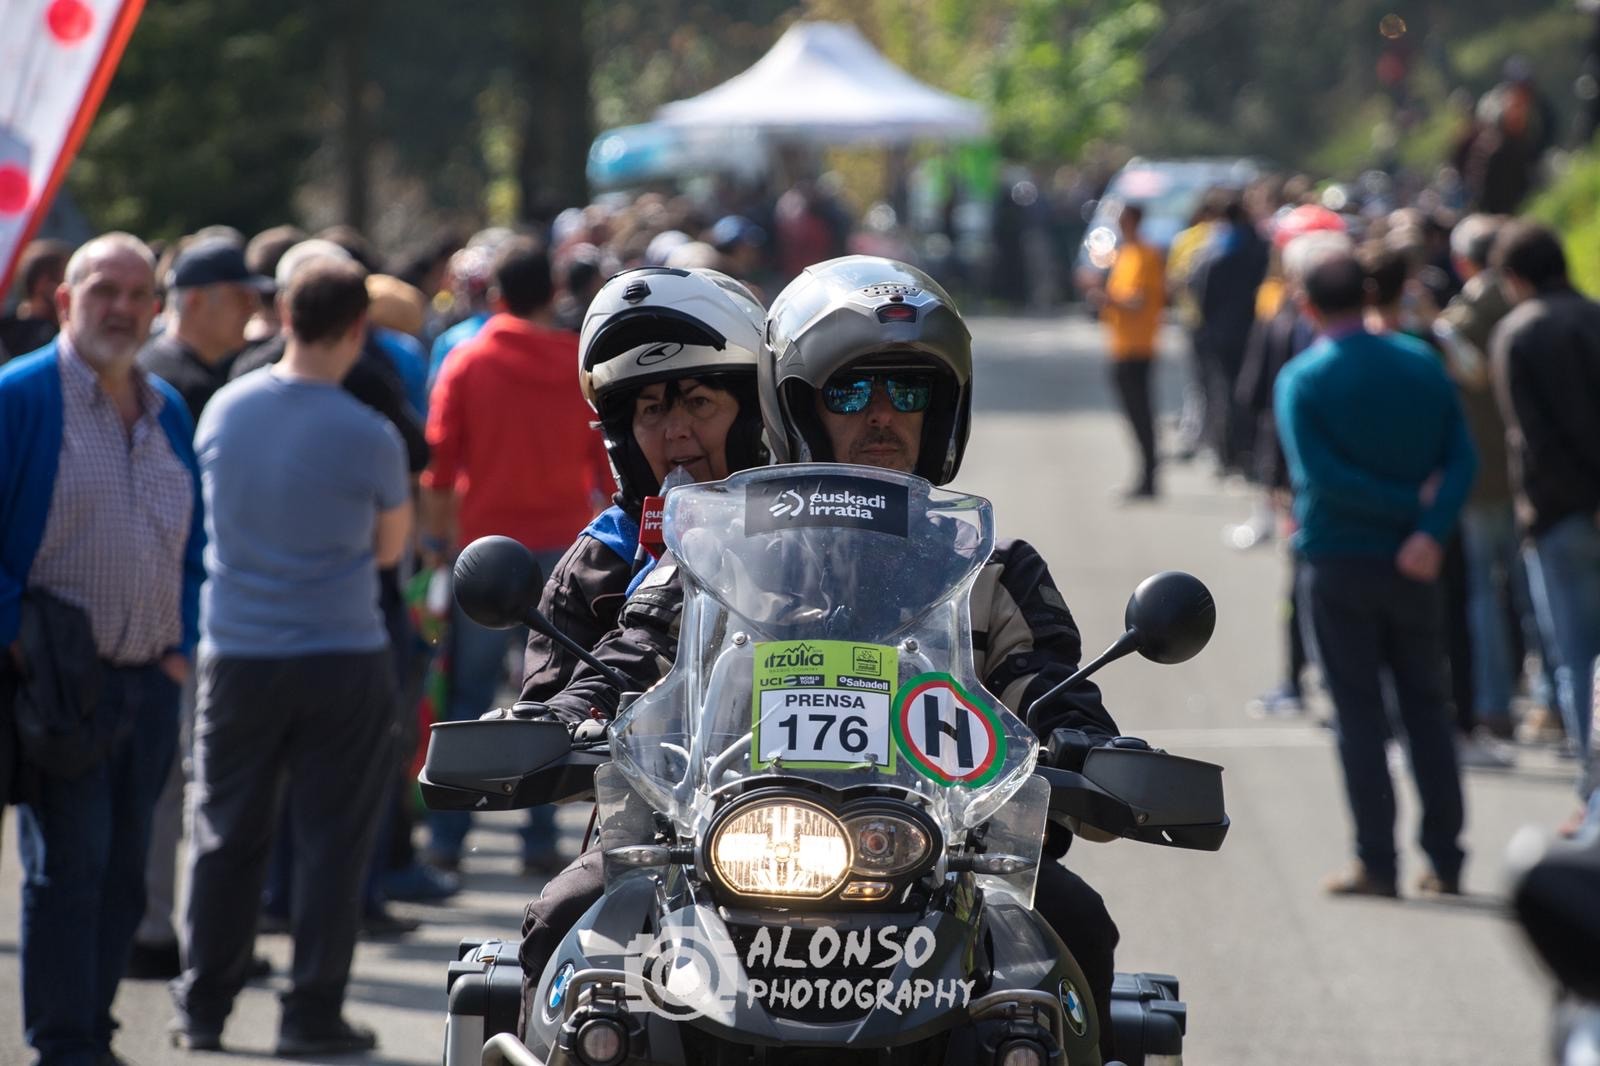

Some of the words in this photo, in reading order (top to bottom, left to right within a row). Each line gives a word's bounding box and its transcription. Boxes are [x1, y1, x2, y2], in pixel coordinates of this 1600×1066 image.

[809, 490, 886, 509] euskadi
[809, 504, 874, 520] irratia
[764, 650, 825, 668] itzulia
[760, 677, 782, 687] UCI
[845, 678, 889, 690] Sabadell
[785, 694, 866, 709] PRENSA
[778, 713, 869, 753] 176
[923, 693, 975, 769] H
